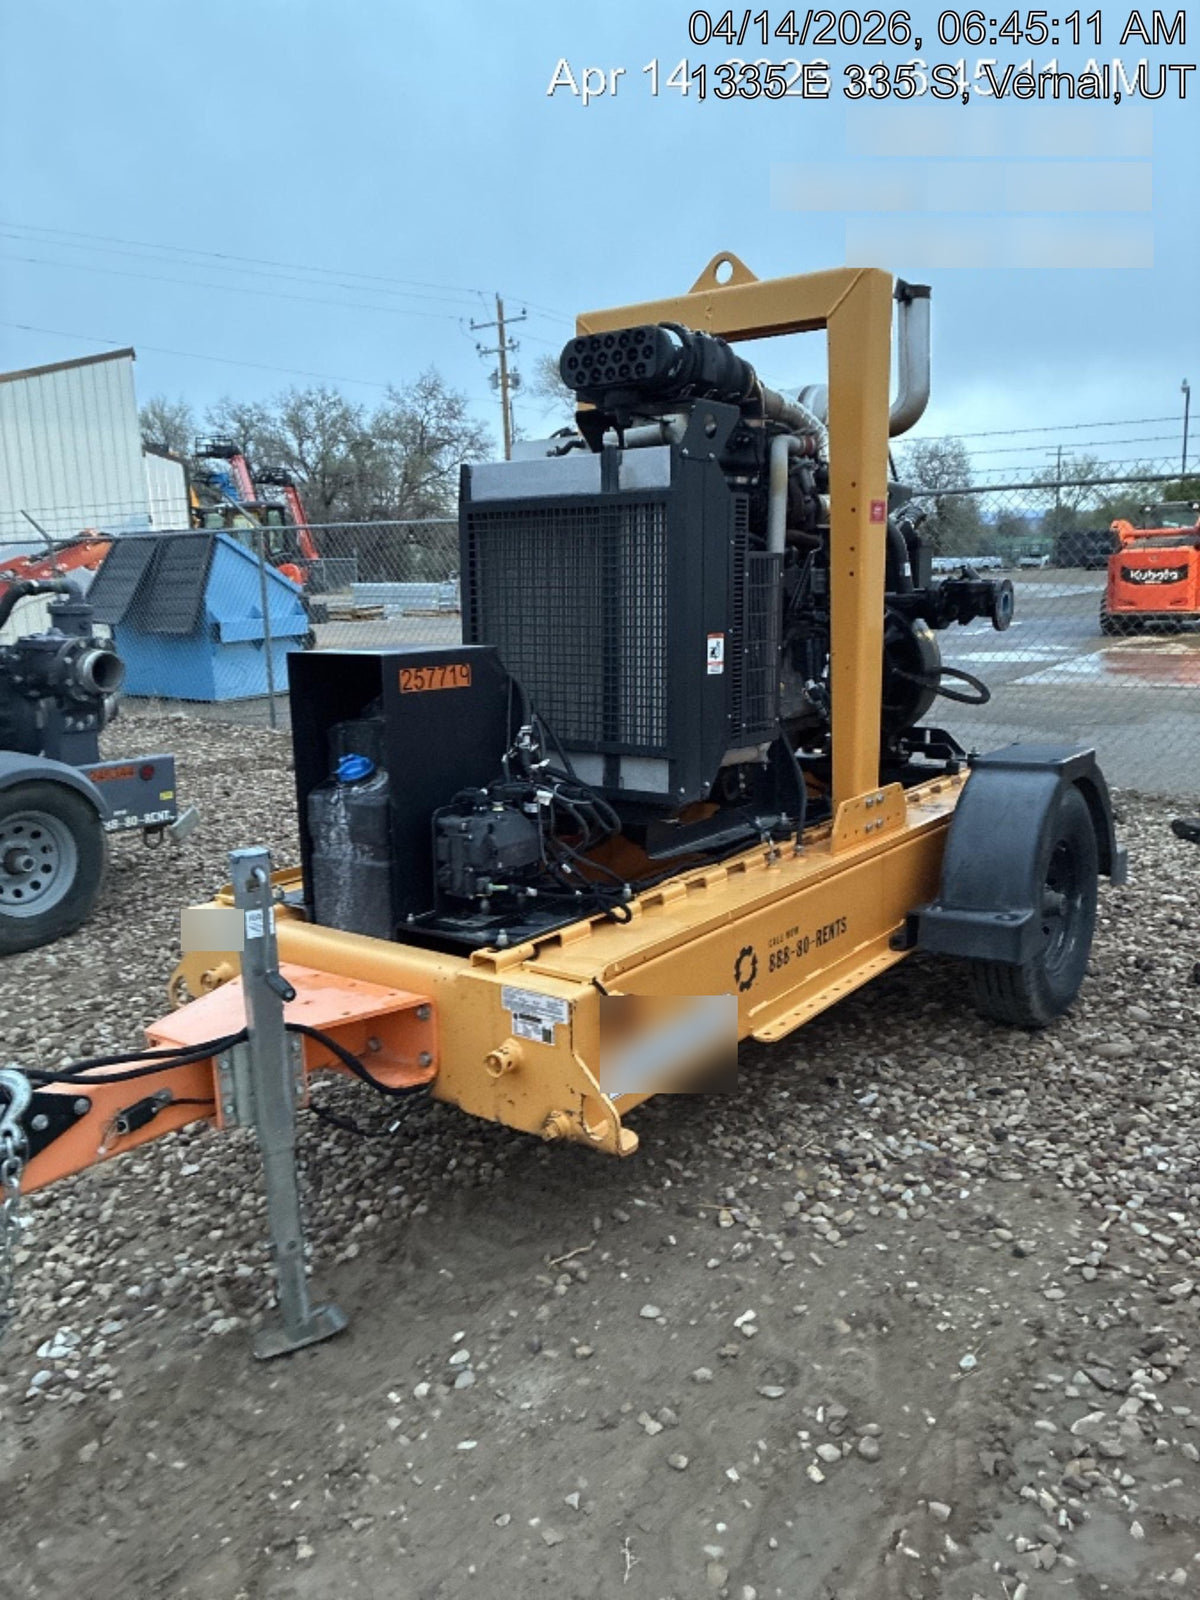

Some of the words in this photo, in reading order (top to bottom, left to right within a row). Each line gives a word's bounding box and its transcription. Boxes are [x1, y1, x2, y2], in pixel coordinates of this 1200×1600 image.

[1130, 568, 1178, 581] Kubota
[401, 664, 470, 690] 257719
[768, 916, 848, 973] 888-80-RENTS
